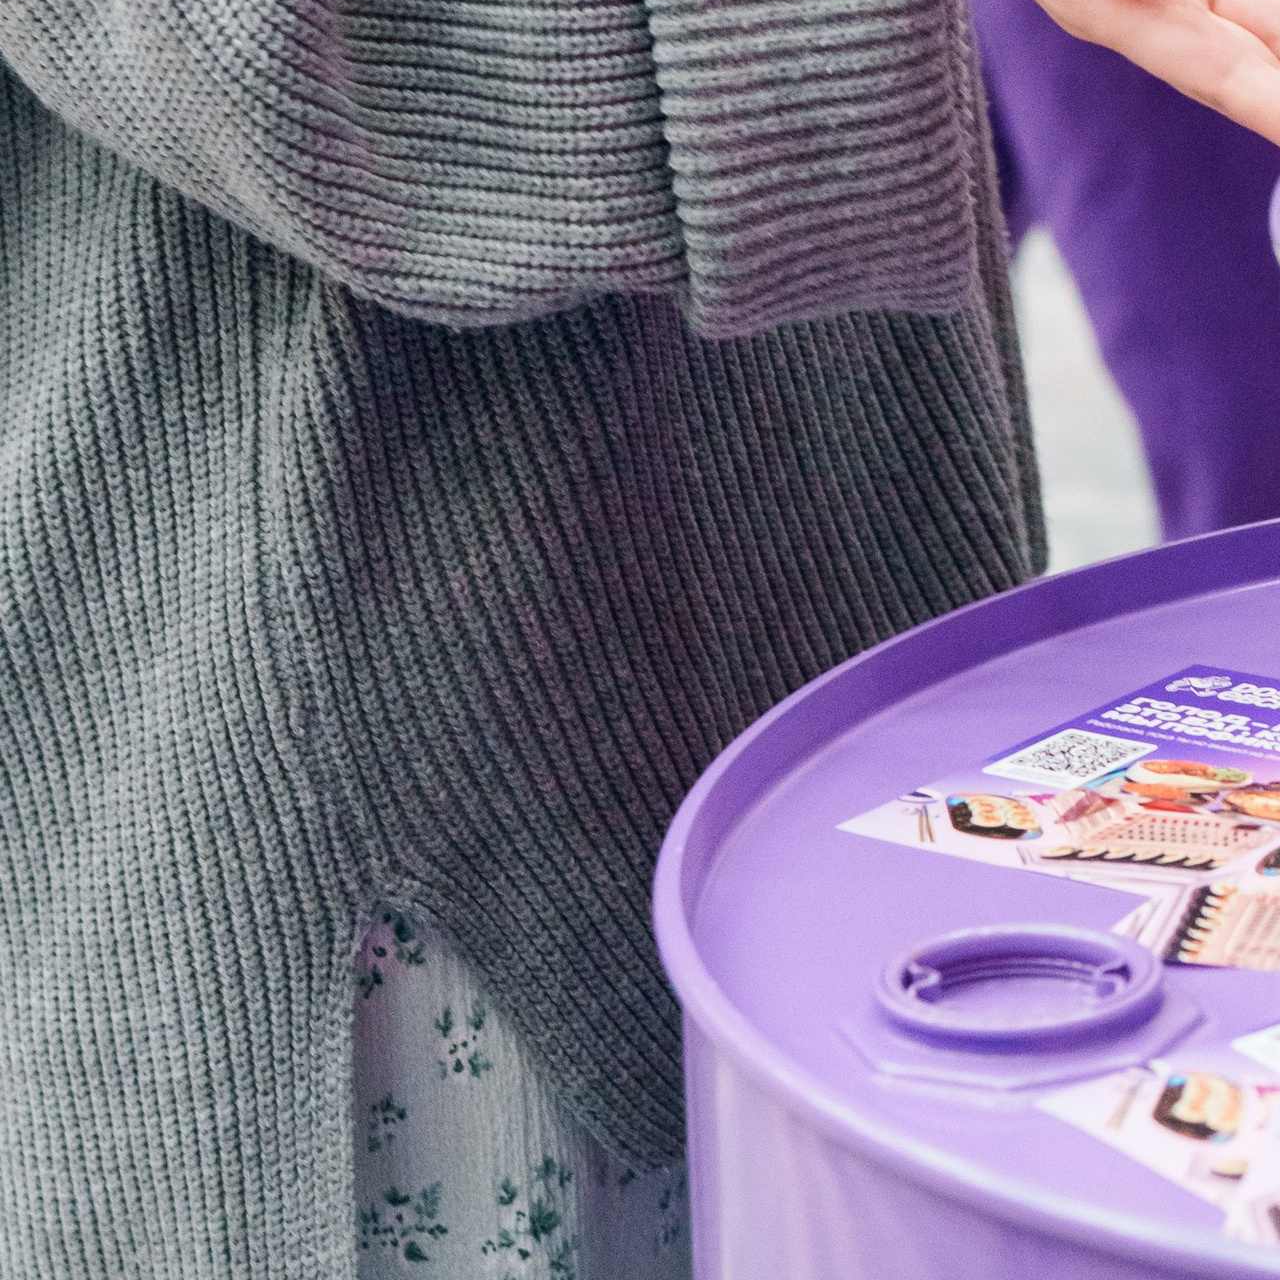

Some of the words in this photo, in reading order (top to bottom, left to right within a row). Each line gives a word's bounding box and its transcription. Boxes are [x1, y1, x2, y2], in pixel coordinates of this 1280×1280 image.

[1100, 709, 1163, 728] МЫ
[1114, 703, 1182, 722] ЭТО
[1129, 696, 1252, 725] ГОЛОД
